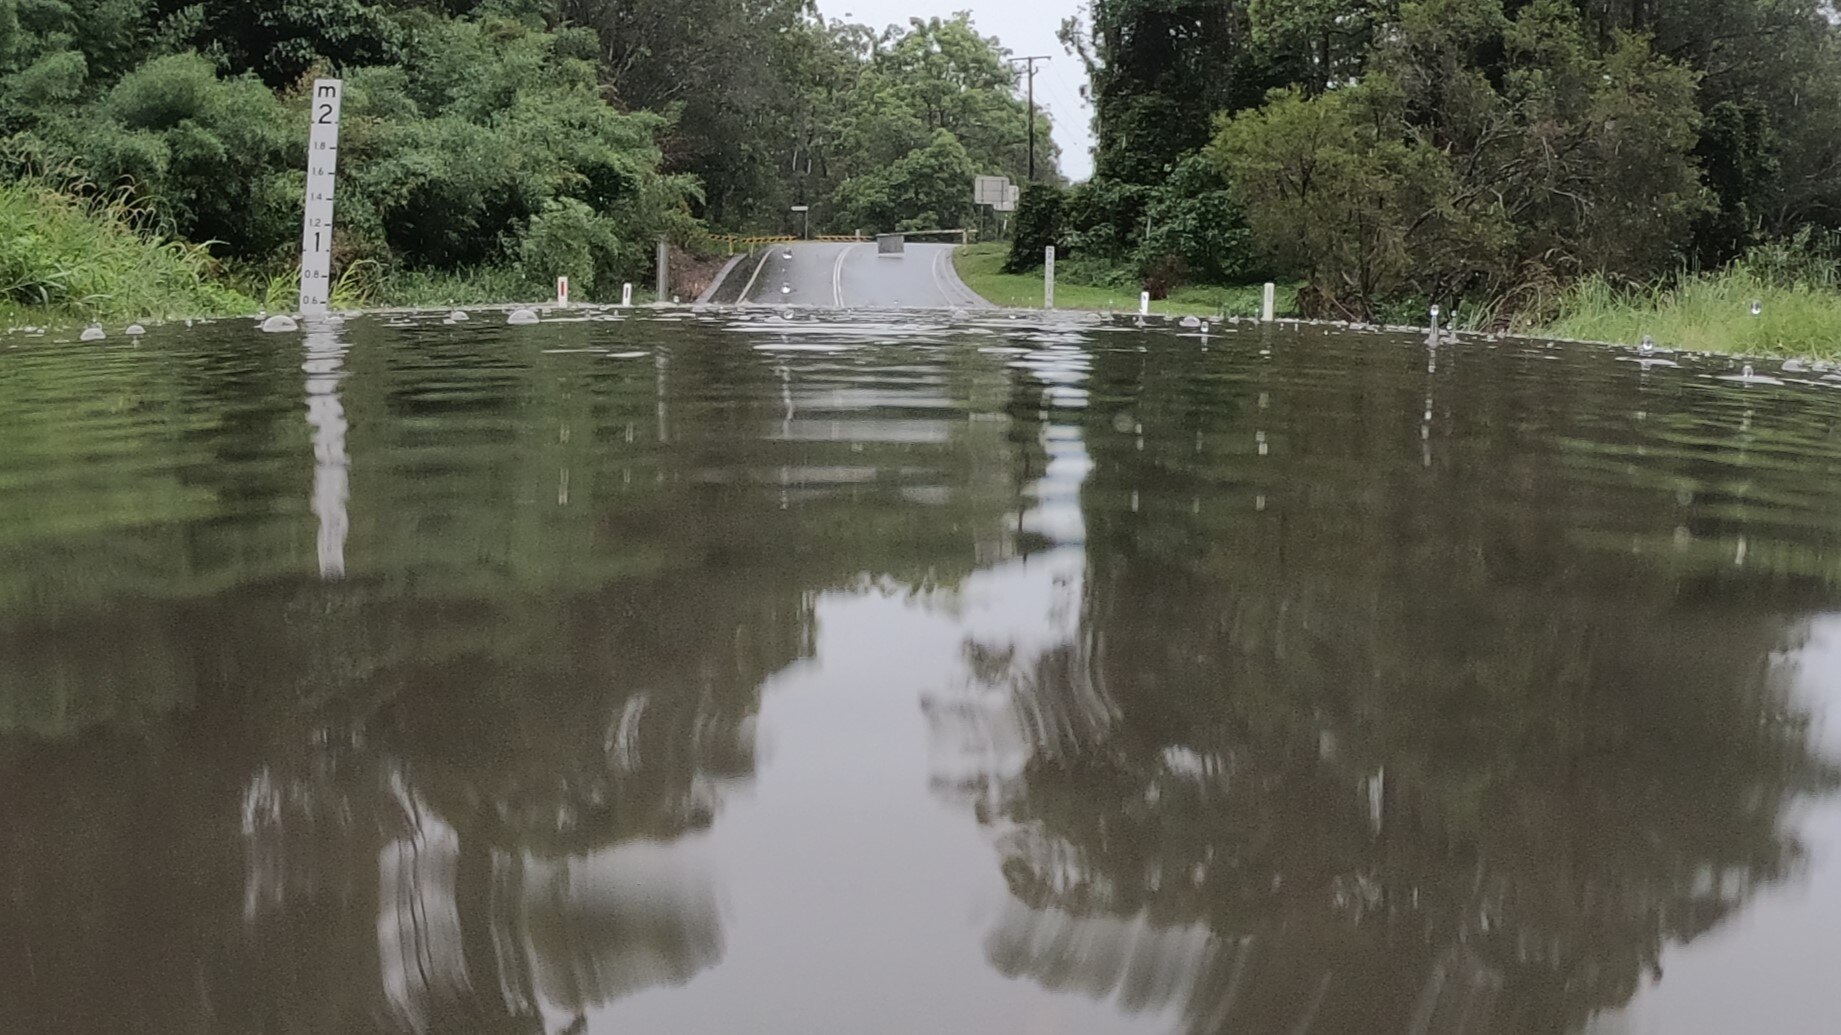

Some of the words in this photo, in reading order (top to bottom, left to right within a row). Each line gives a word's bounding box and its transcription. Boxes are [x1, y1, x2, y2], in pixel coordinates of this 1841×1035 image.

[317, 86, 336, 98] m
[318, 103, 333, 124] 2
[314, 142, 326, 150] 1.8
[312, 167, 324, 175] 1.6
[311, 193, 322, 201] 1.4
[309, 218, 321, 227] 1.2
[314, 231, 320, 253] 1
[304, 270, 319, 279] 0.8
